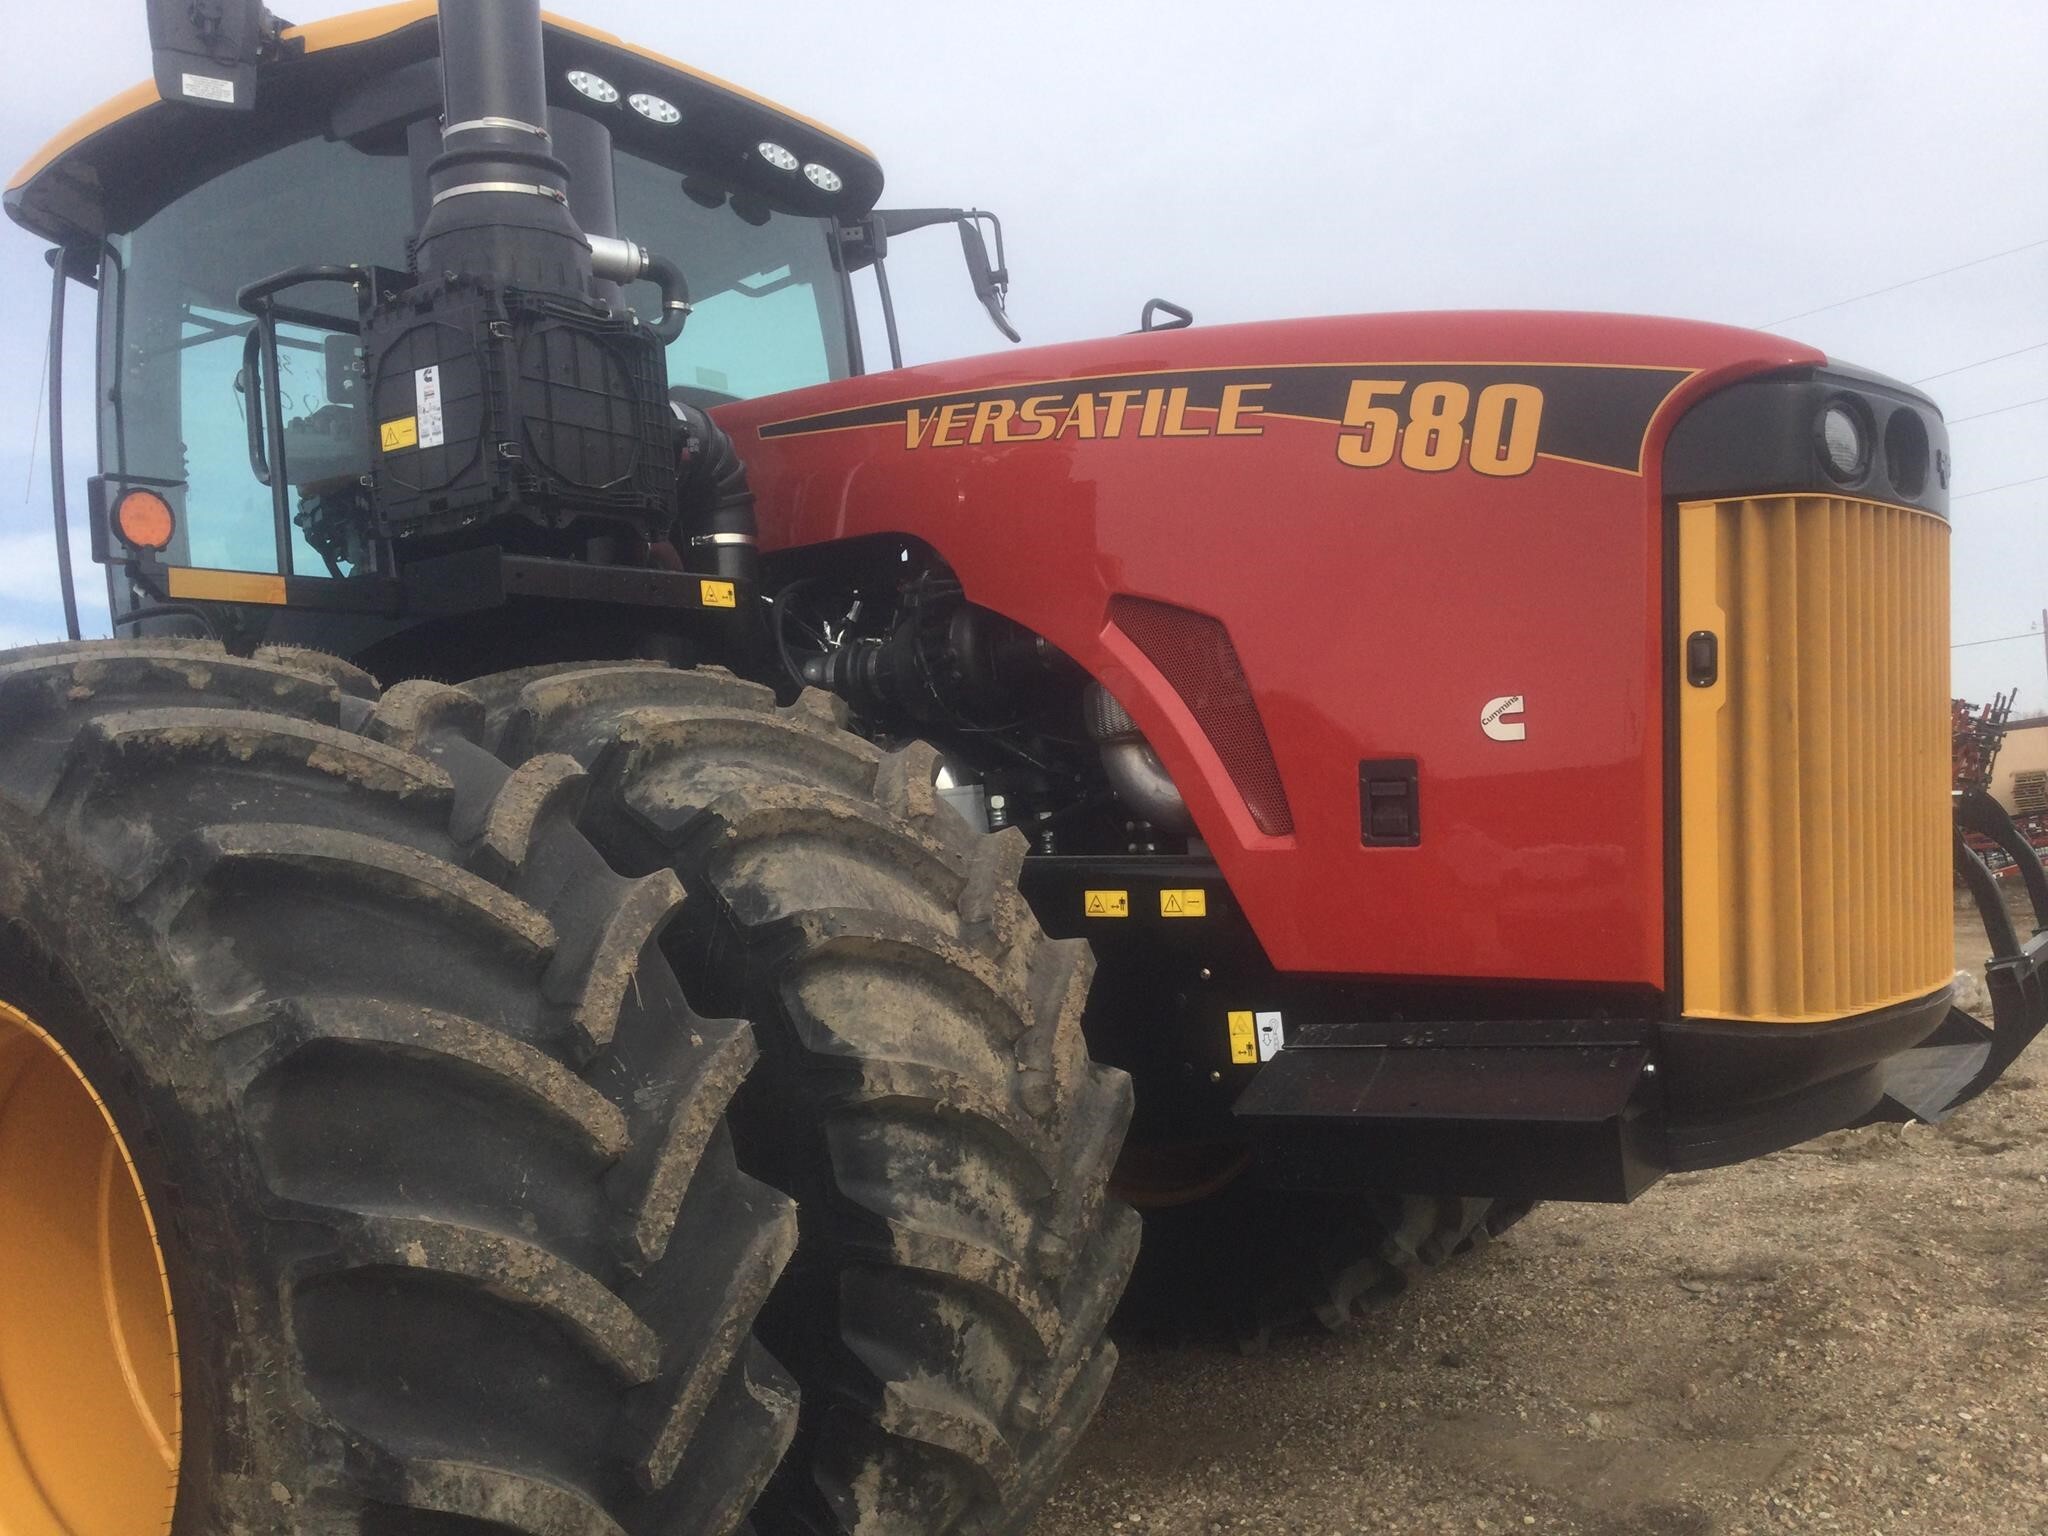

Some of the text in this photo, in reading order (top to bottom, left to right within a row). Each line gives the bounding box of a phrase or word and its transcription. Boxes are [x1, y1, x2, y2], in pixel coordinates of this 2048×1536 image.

[905, 378, 1545, 477] VERSATILE 580
[1481, 695, 1519, 726] Cummins
